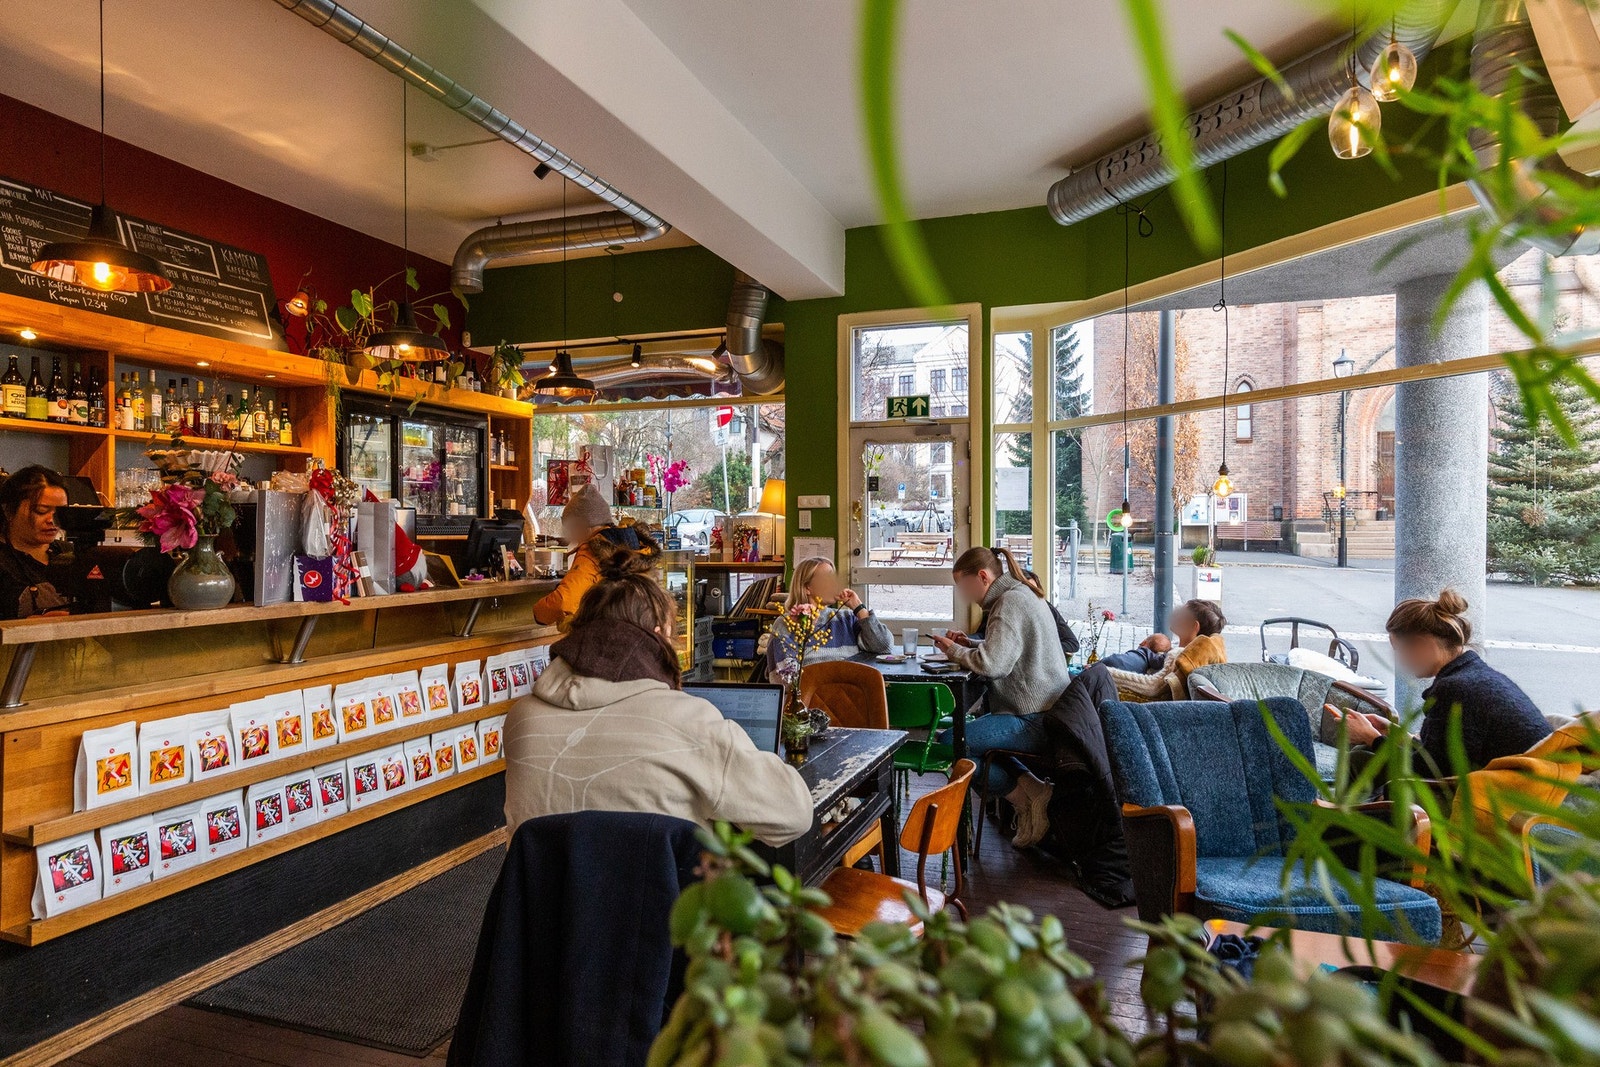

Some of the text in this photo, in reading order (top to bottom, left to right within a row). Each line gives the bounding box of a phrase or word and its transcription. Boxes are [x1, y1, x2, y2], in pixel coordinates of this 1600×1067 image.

[34, 188, 53, 201] MAT
[15, 214, 45, 230] PUDDING
[220, 248, 259, 271] KAMPEN
[16, 272, 46, 288] WIFI:
[83, 297, 108, 311] 1234
